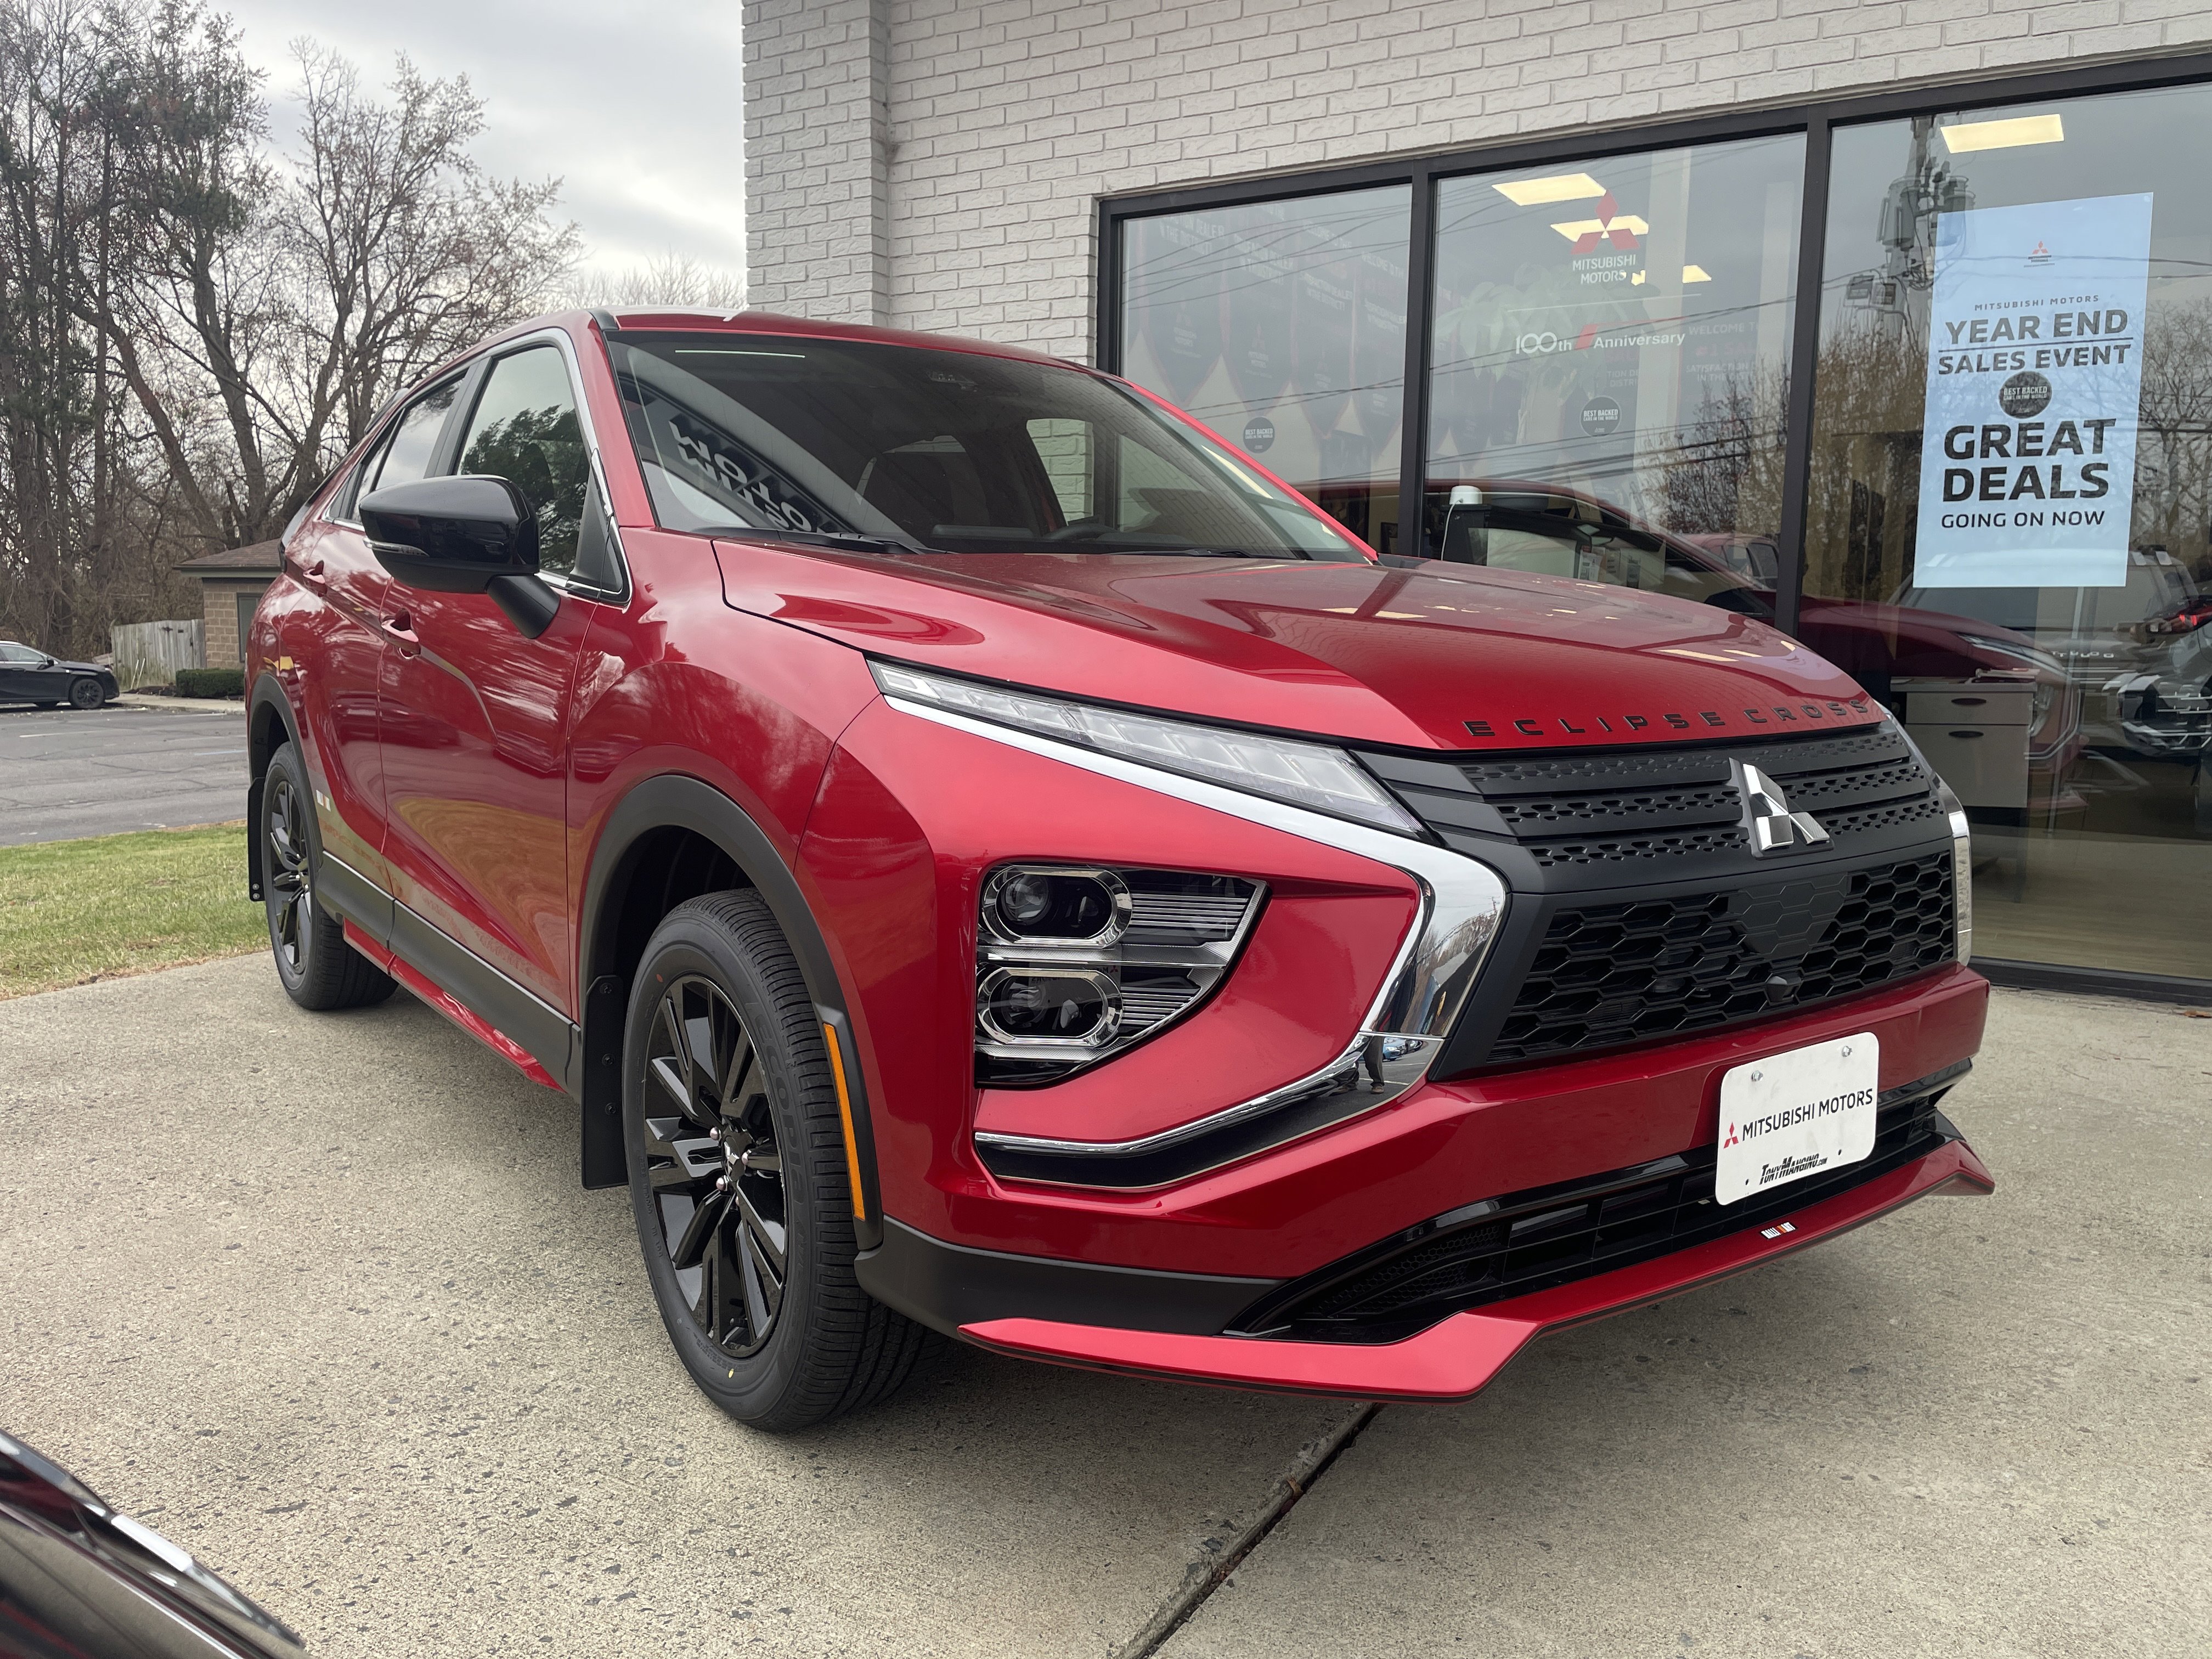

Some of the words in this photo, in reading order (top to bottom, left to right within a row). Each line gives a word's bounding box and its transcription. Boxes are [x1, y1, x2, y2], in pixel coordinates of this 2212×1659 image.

[1572, 254, 1636, 272] MITSUBISHI
[1580, 269, 1626, 284] MOTORS
[1974, 298, 2045, 311] MITSUBISHI
[2050, 295, 2100, 306] MOTORS
[1945, 317, 2040, 345] YEAR
[2054, 309, 2128, 337] END
[1515, 331, 1572, 354] 100th
[1593, 331, 1686, 349] Anniversary
[1938, 351, 2025, 374] SALES
[2036, 344, 2131, 369] EVENT
[1944, 418, 2117, 459] GREAT
[1943, 462, 2109, 503] DEALS
[1941, 512, 2006, 529] GOING
[2014, 511, 2044, 527] ON
[2052, 510, 2105, 526] NOW
[1463, 711, 1726, 737] ECLIPSE
[1743, 699, 1869, 724] CROSS
[1742, 1103, 1815, 1141] MITSUBISHI
[1819, 1088, 1873, 1118] MOTORS
